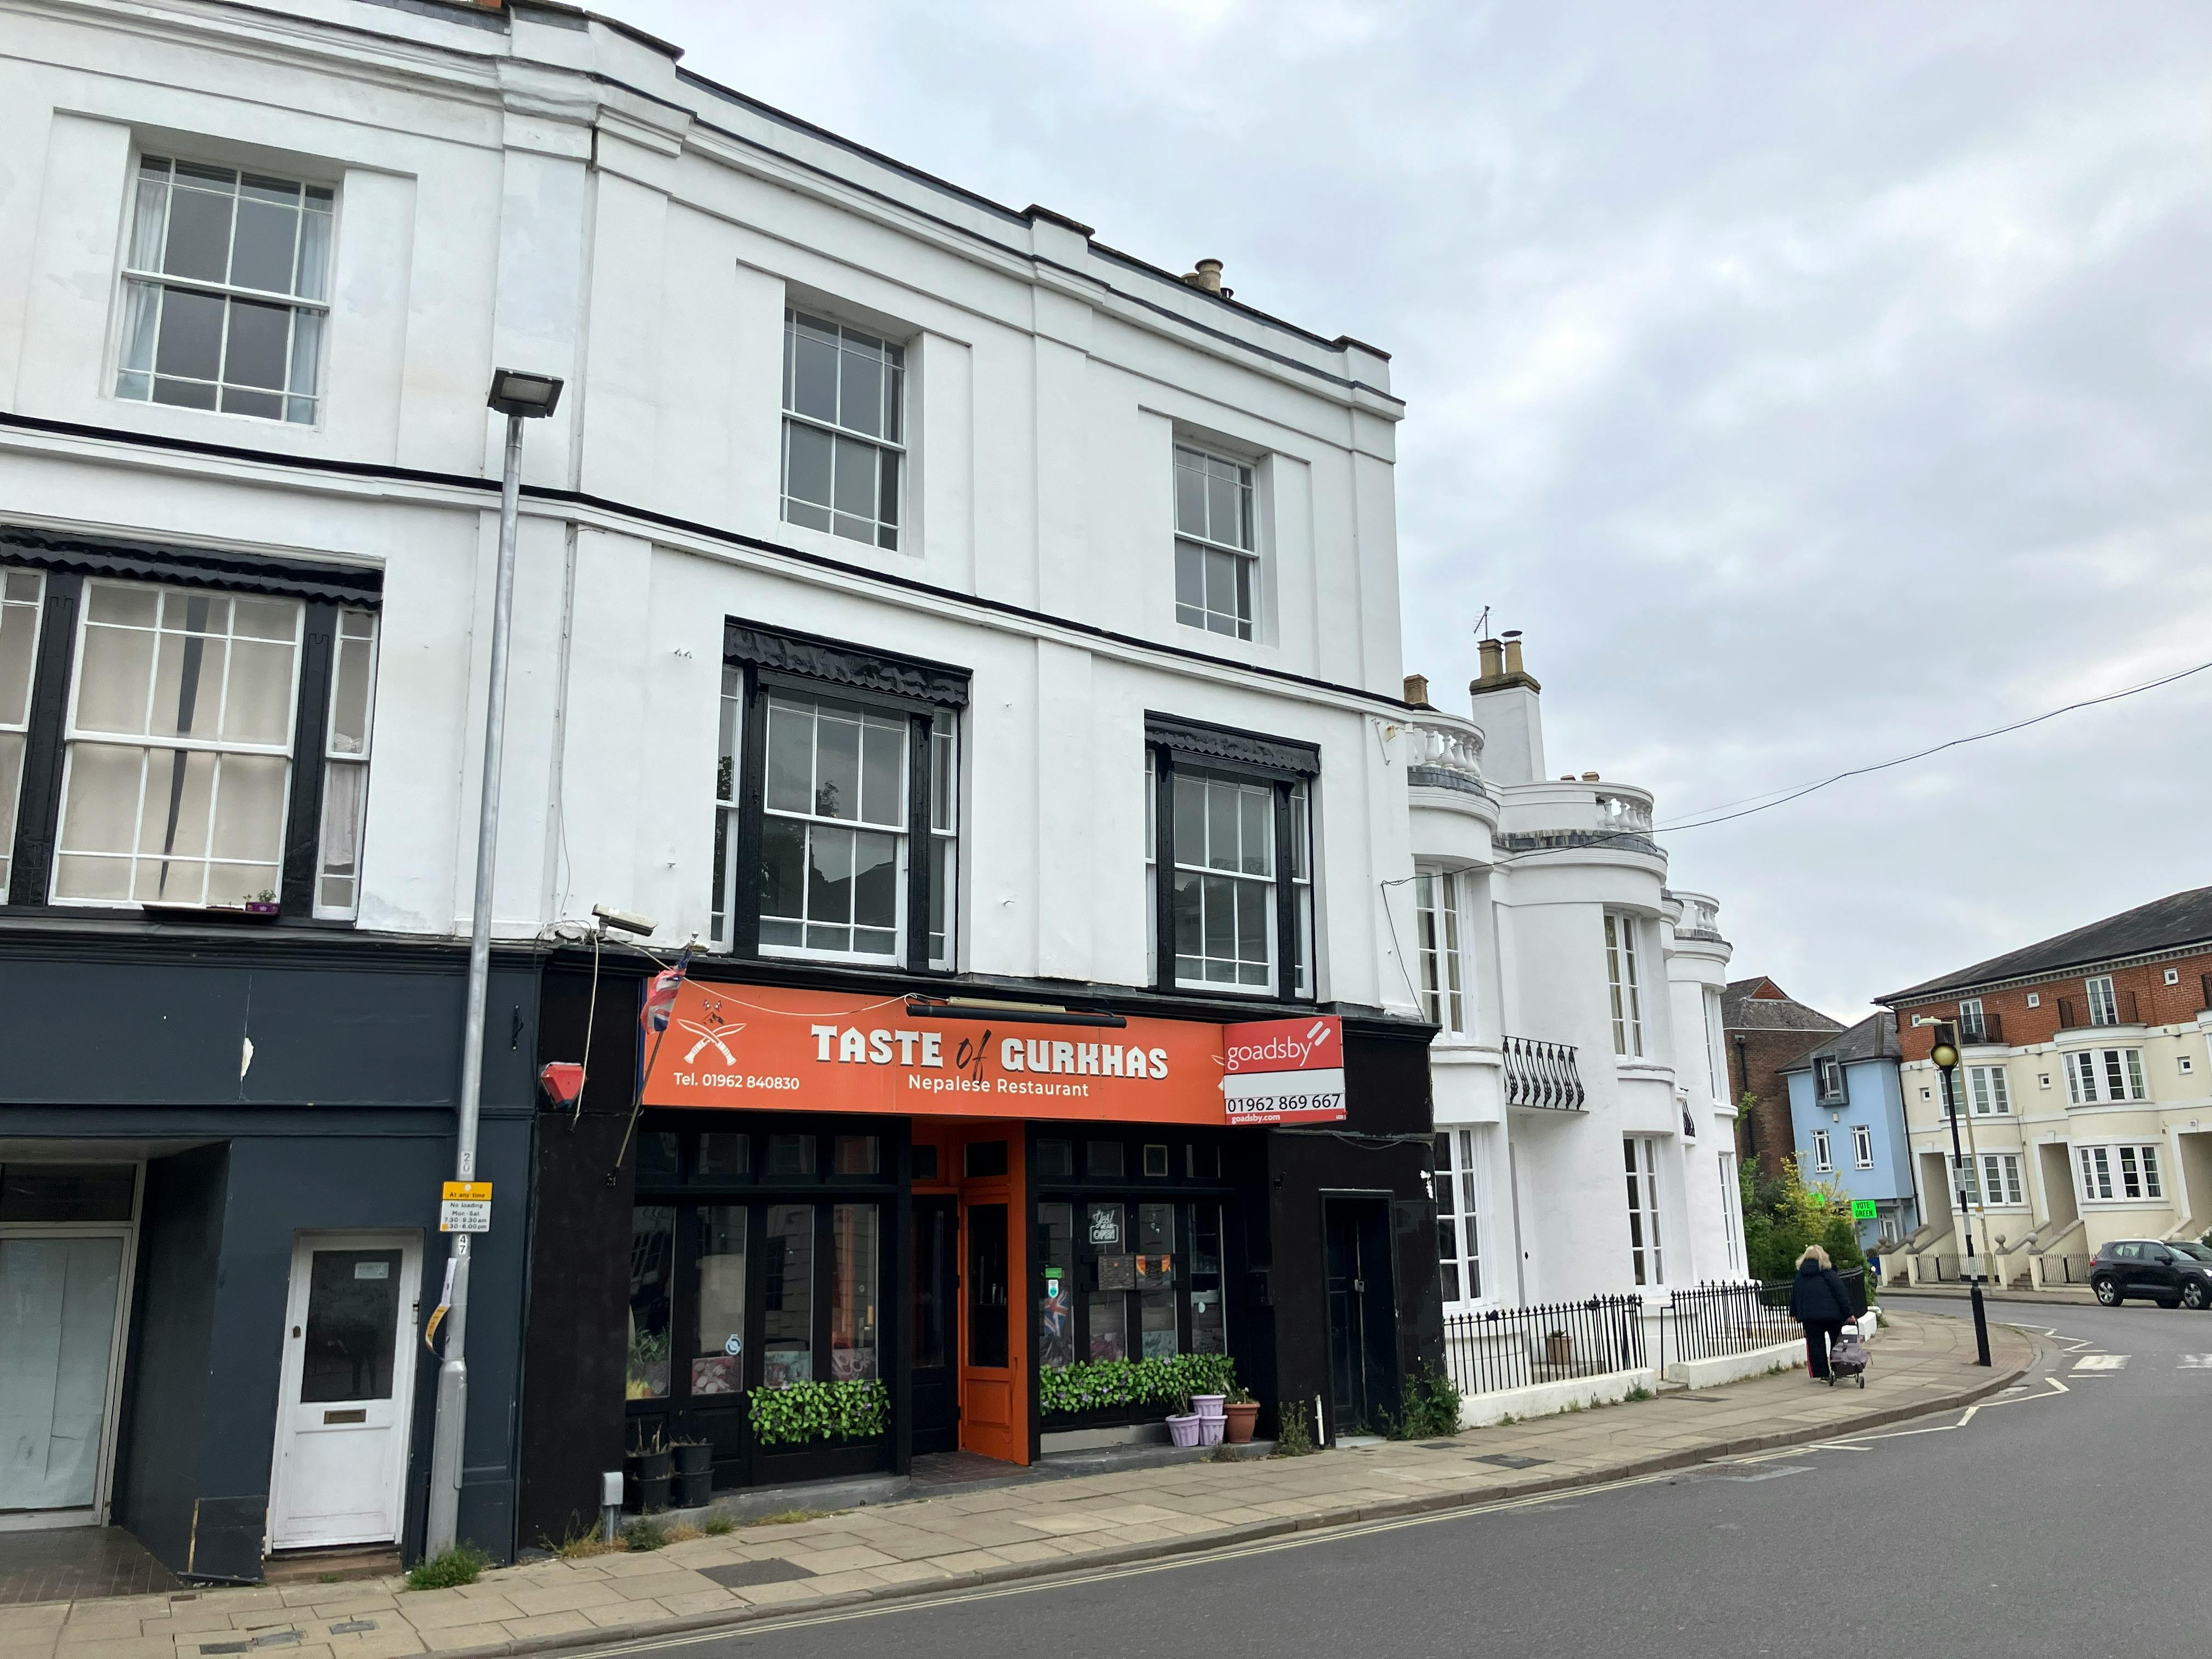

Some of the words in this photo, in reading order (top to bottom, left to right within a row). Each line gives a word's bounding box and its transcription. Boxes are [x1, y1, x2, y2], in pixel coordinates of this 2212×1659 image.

[811, 1024, 944, 1069] TASTE
[956, 1029, 992, 1086] of
[1001, 1038, 1168, 1079] GURKHAS
[1227, 1036, 1312, 1070] goadsby
[673, 1072, 698, 1086] Tel.
[702, 1074, 743, 1087] 01962
[747, 1076, 800, 1090] 840830
[909, 1074, 991, 1094] Nepalese
[997, 1078, 1088, 1097] Restaurant
[1228, 1097, 1274, 1113] 01962
[1279, 1096, 1307, 1110] 869
[1312, 1094, 1341, 1109] 667
[1232, 1114, 1280, 1125] goadsby.com
[1093, 1210, 1115, 1228] Yes!
[1093, 1229, 1115, 1239] OPEN
